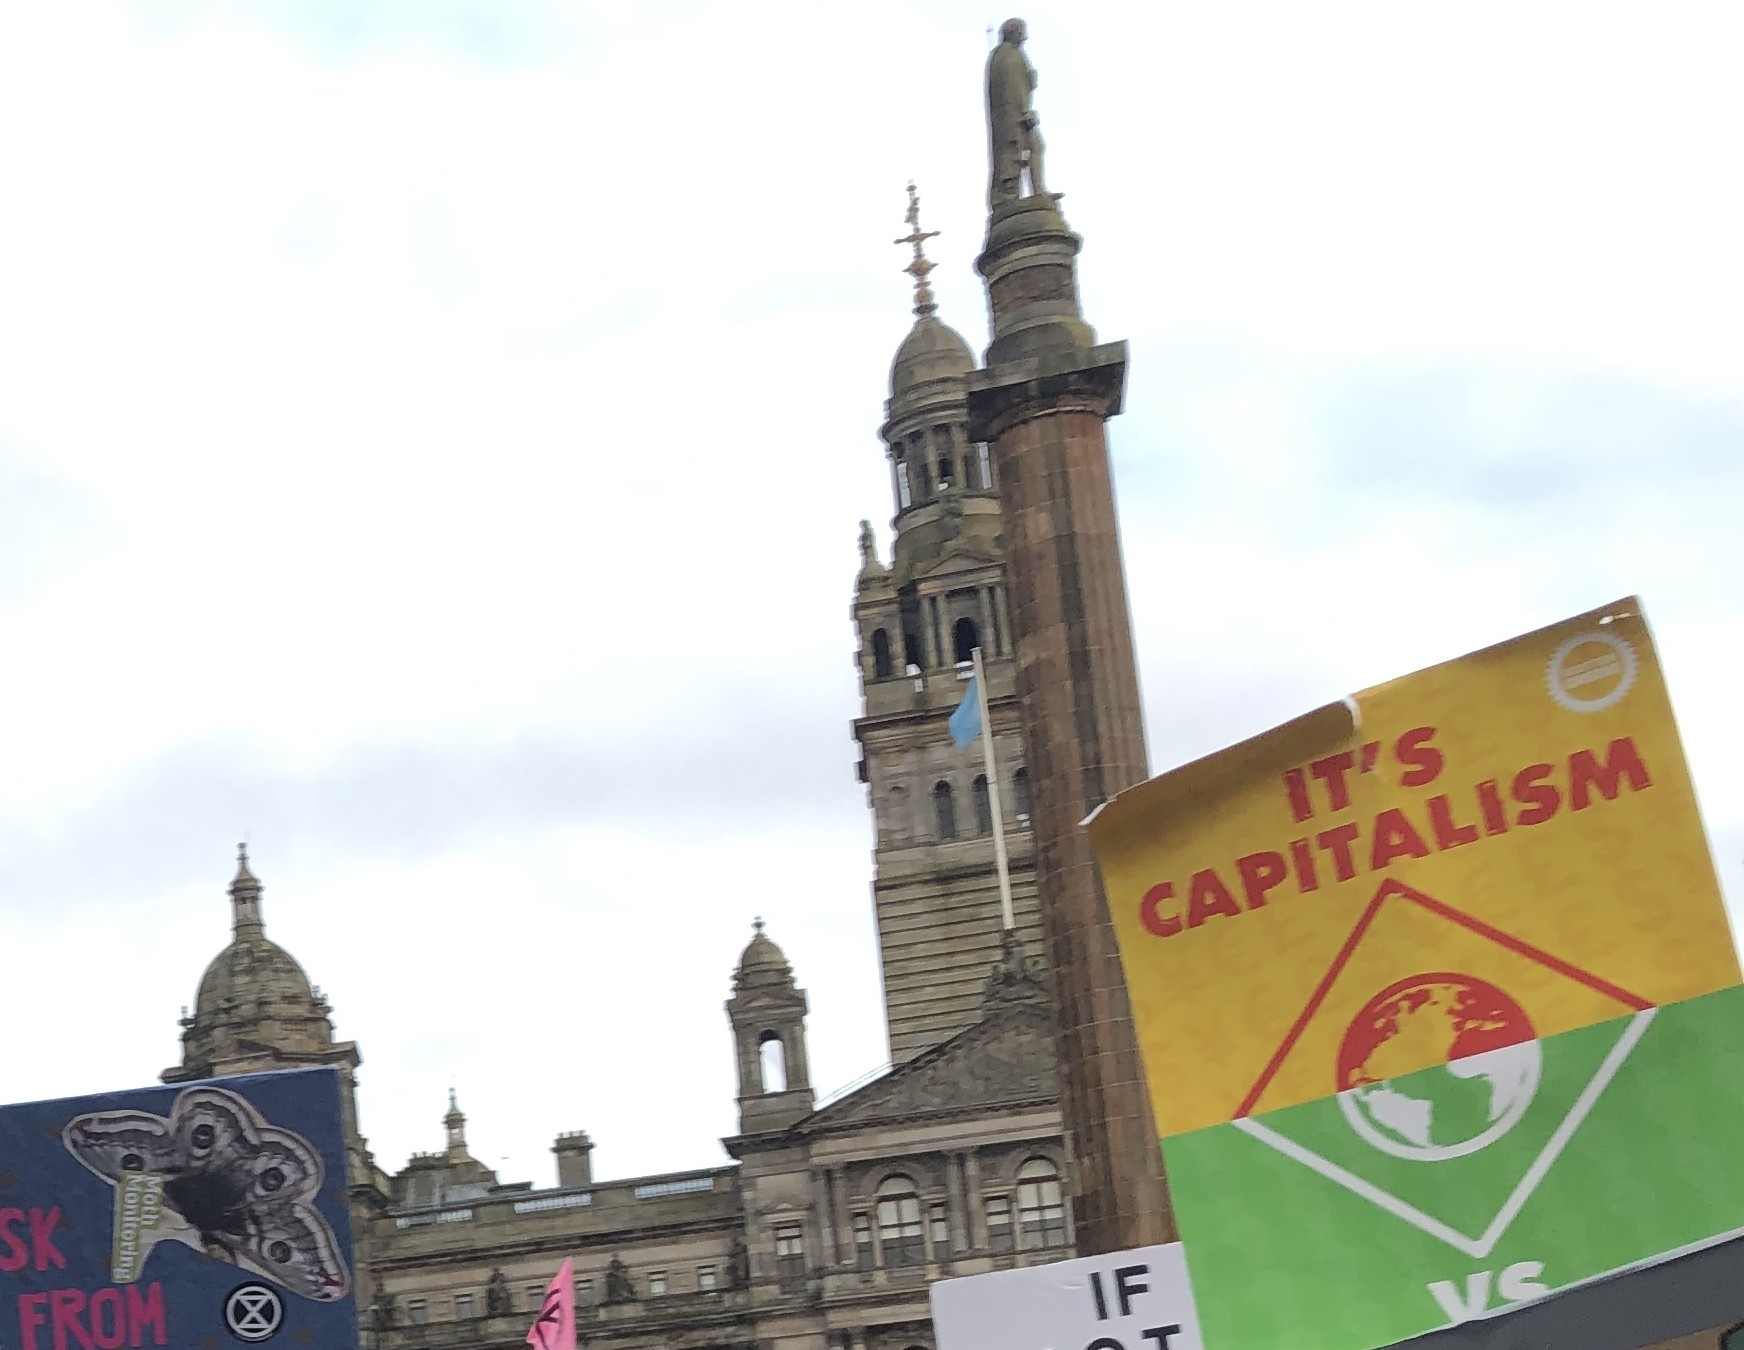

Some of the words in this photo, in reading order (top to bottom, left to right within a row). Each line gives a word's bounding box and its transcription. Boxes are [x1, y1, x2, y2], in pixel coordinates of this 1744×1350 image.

[1283, 726, 1445, 823] IT'S
[1139, 736, 1654, 939] CAPITALISM
[1088, 1263, 1151, 1321] IF
